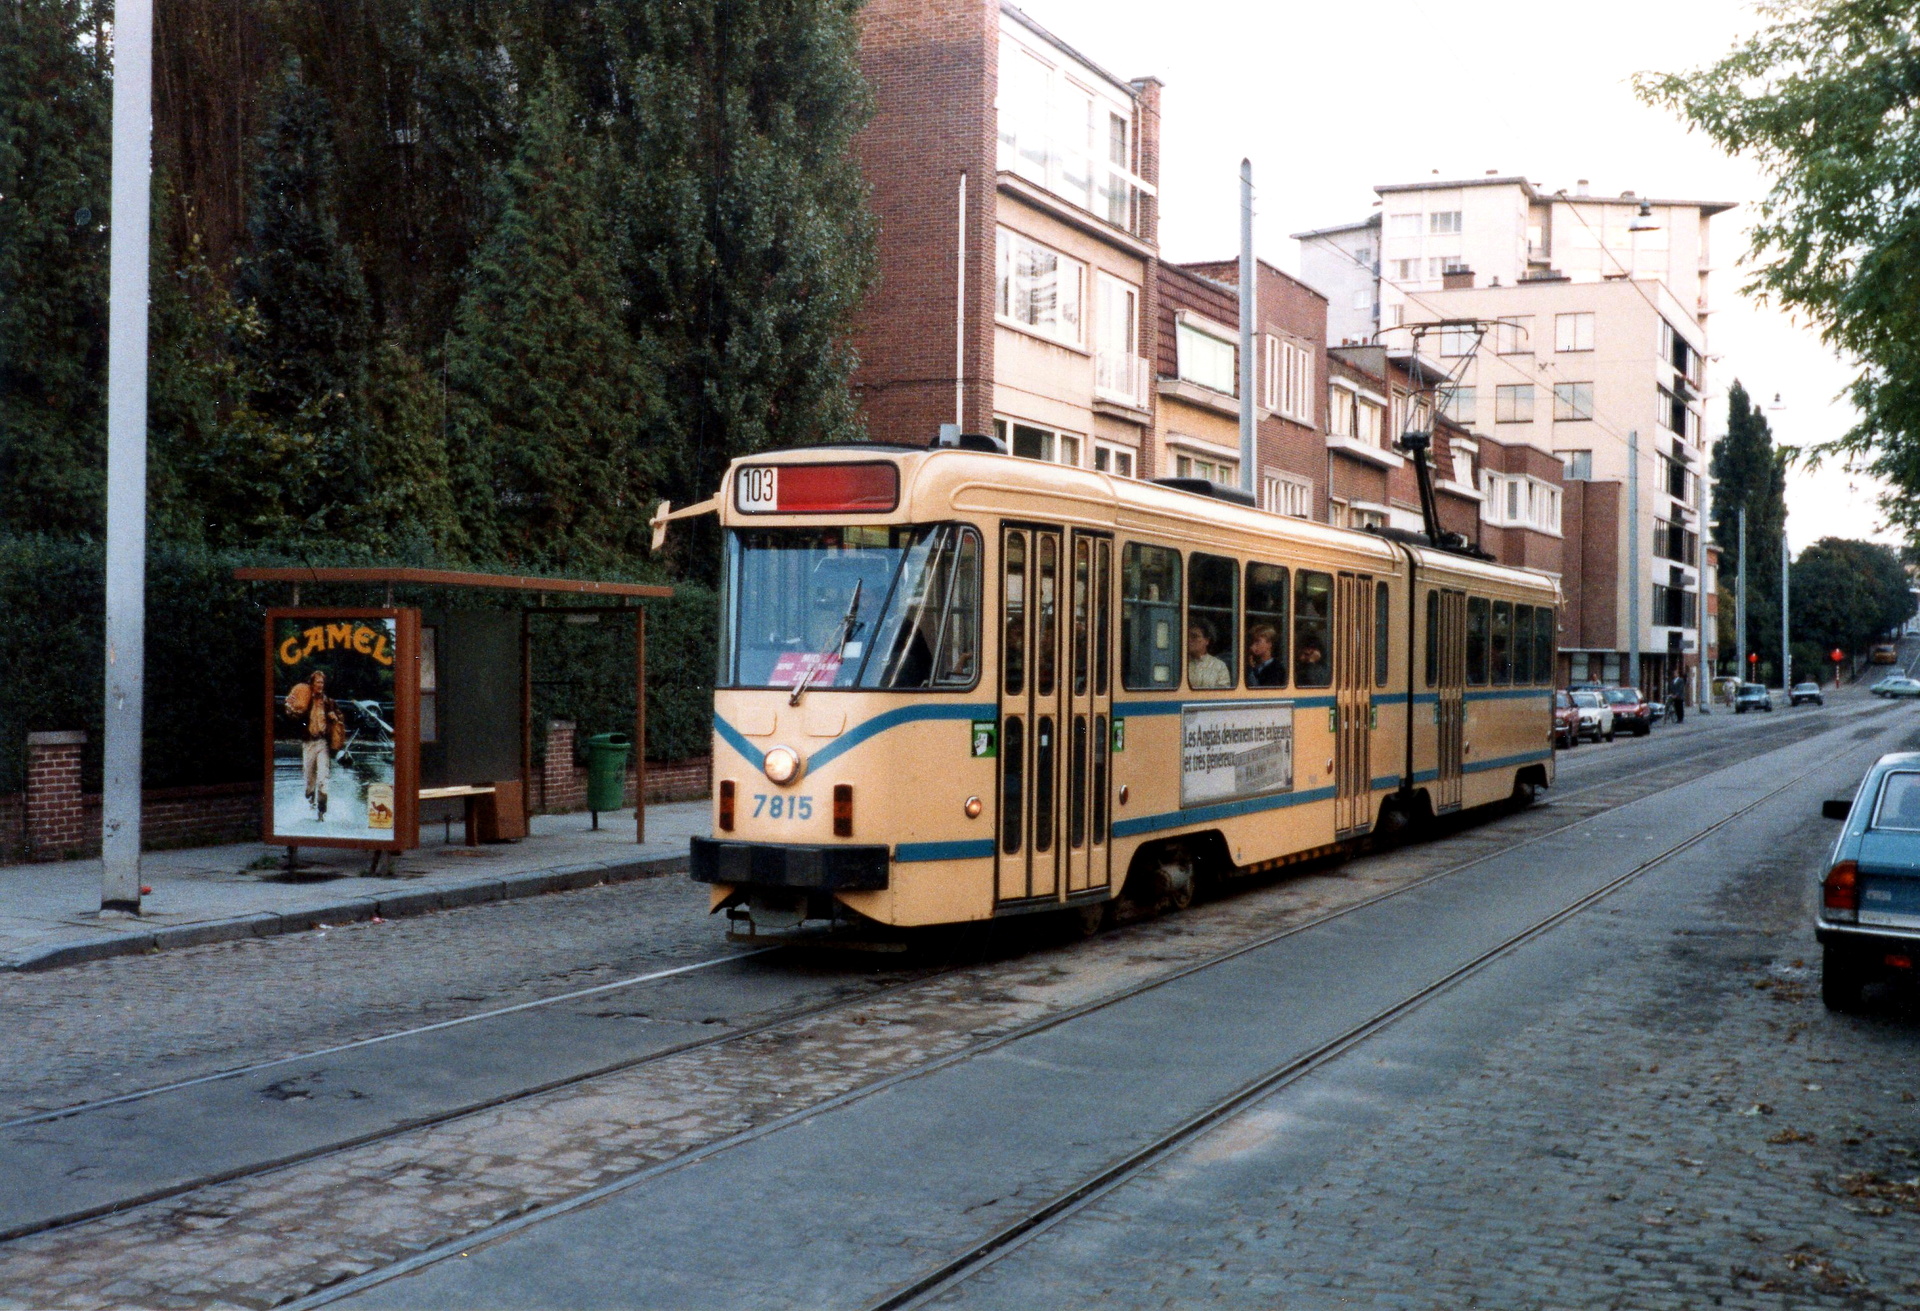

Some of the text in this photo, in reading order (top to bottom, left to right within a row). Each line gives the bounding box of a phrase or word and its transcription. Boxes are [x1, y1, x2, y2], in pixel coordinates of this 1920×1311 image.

[743, 468, 773, 502] 103
[280, 623, 393, 666] CAMEL
[1184, 726, 1196, 748] Les
[1197, 723, 1221, 751] Anglais
[753, 794, 814, 820] 7815
